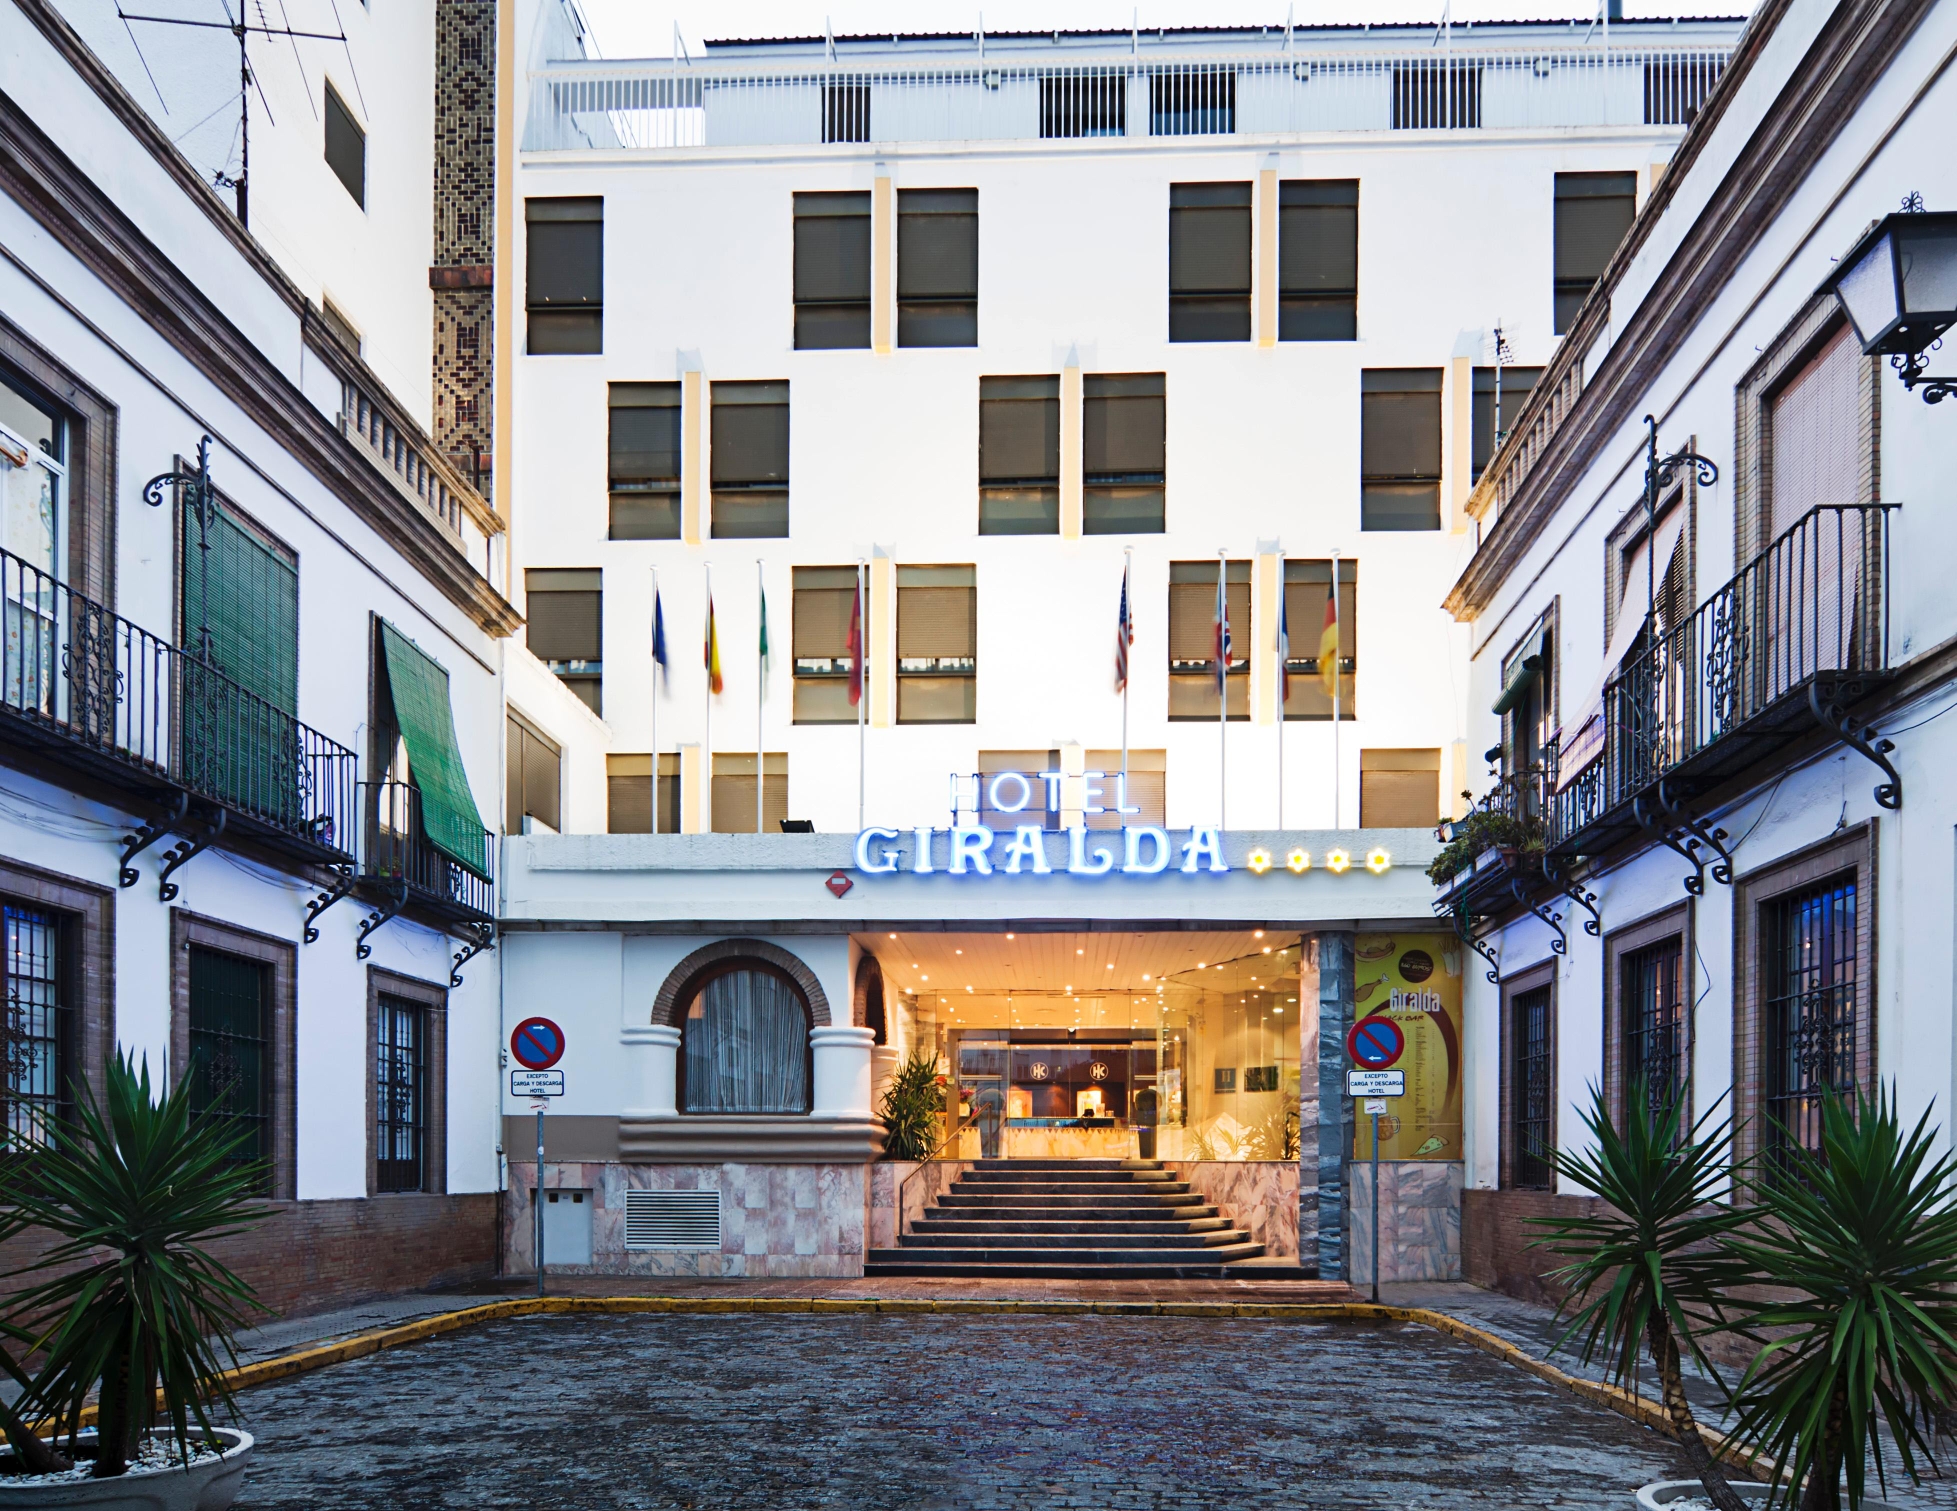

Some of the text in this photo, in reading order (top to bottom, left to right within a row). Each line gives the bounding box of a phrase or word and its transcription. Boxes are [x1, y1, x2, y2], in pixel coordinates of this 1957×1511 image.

[950, 772, 1140, 812] HOTEL
[854, 825, 1230, 874] GIRALDA
[1390, 987, 1440, 1012] Giralda
